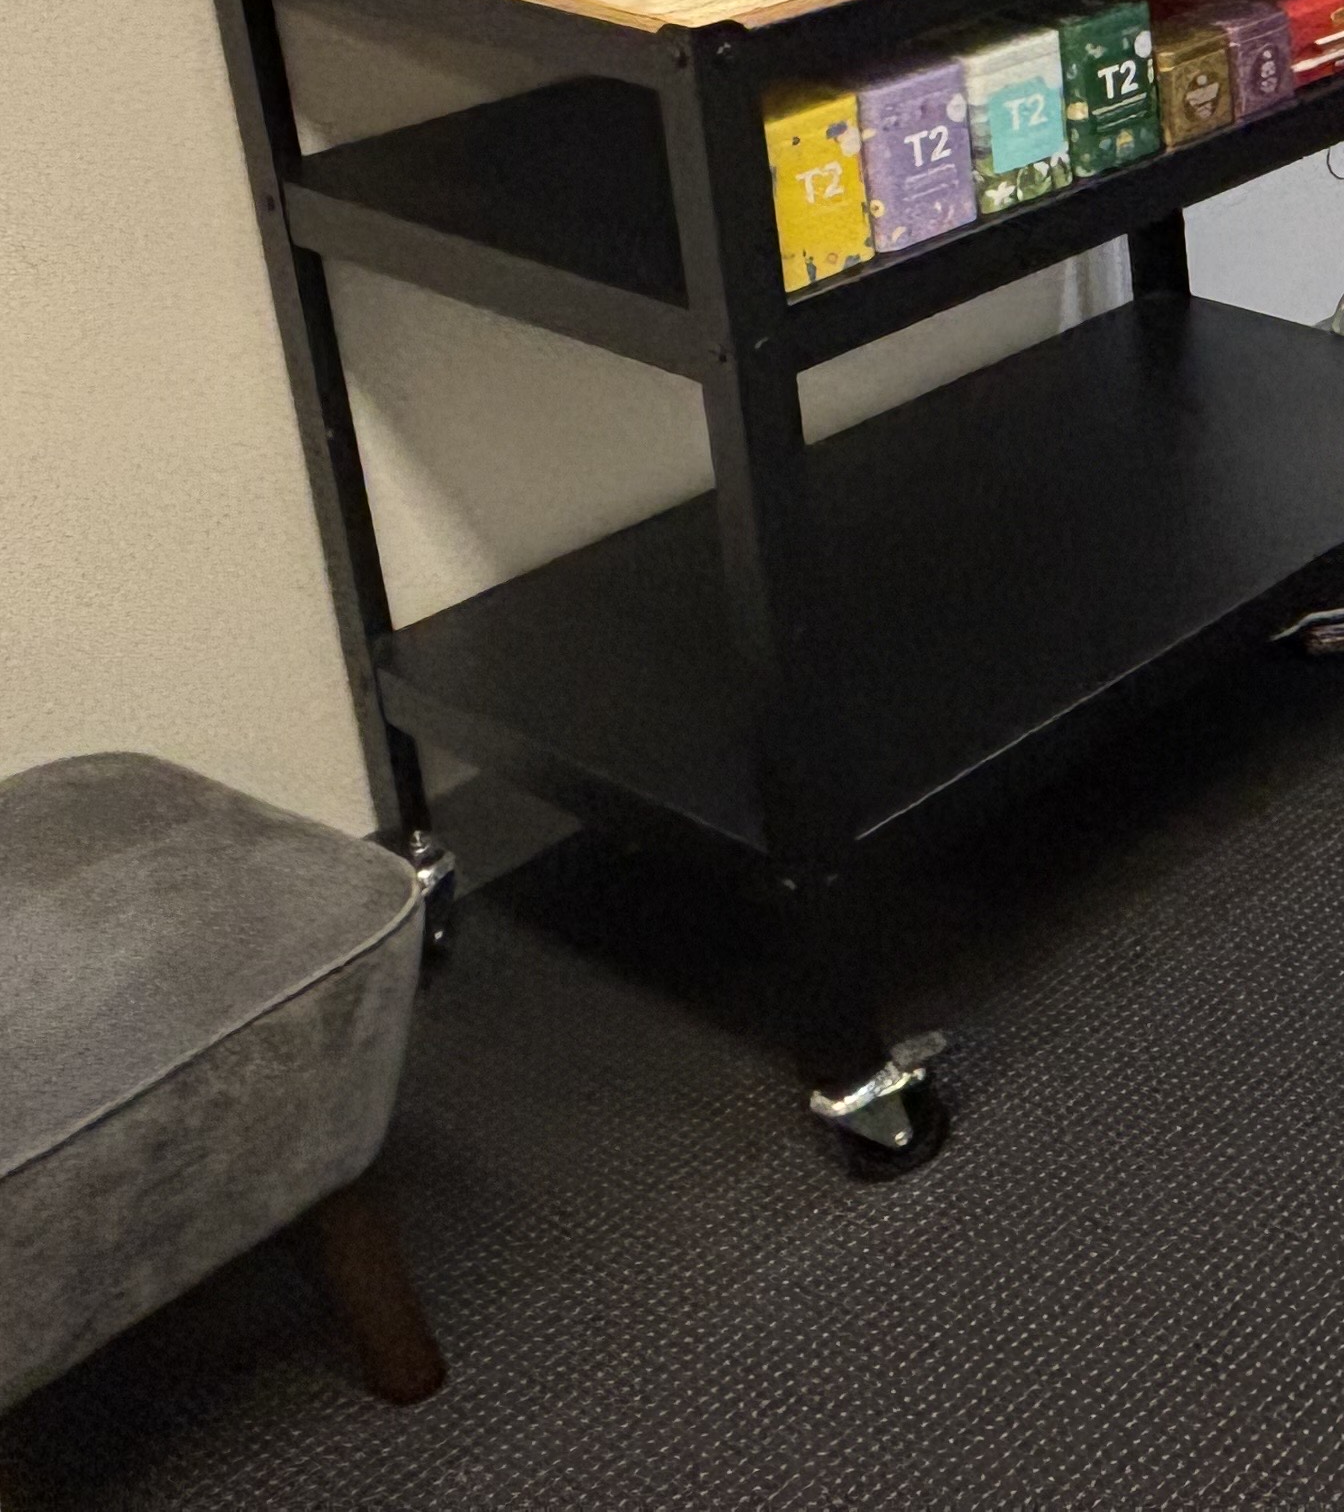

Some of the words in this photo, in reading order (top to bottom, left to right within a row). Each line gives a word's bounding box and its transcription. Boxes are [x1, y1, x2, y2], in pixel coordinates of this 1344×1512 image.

[1097, 59, 1140, 100] T2
[1002, 92, 1050, 131] T2
[903, 124, 953, 168] T2
[795, 160, 845, 205] T2
